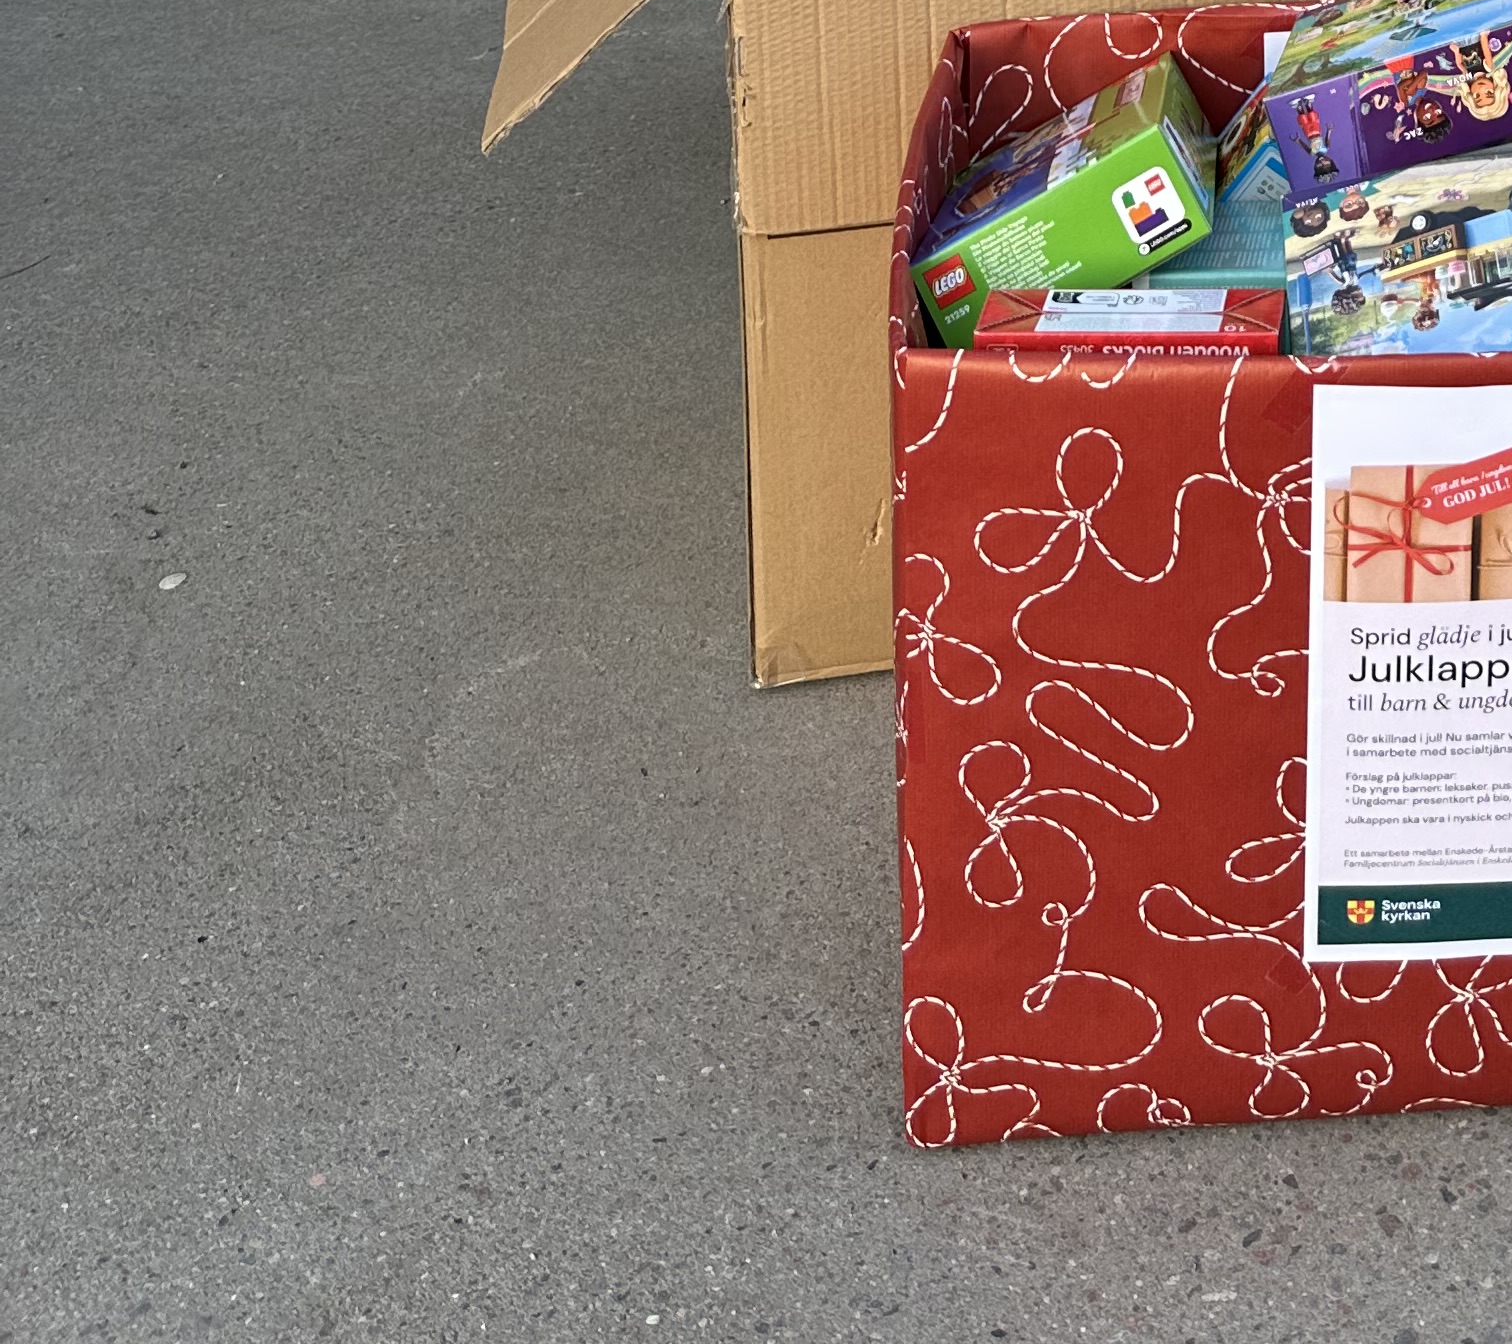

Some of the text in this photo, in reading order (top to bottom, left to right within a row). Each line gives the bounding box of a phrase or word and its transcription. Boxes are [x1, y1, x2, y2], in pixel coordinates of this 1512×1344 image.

[1446, 72, 1474, 87] NOVA
[1405, 127, 1424, 141] ZAC
[933, 268, 967, 298] LEGO
[1443, 489, 1476, 507] GOD
[1480, 476, 1510, 496] JUL!
[1351, 627, 1410, 649] Sprid
[1418, 624, 1480, 650] glädje
[1348, 694, 1372, 710] till
[1381, 692, 1425, 711] barn
[1346, 733, 1368, 742] Gör
[1371, 733, 1416, 743] skillnad
[1445, 732, 1462, 741] Nu
[1465, 731, 1505, 741] samlar
[1352, 748, 1416, 756] samarbete
[1420, 745, 1446, 755] med
[1381, 898, 1440, 911] Svenska
[1381, 909, 1430, 923] kyrkan
